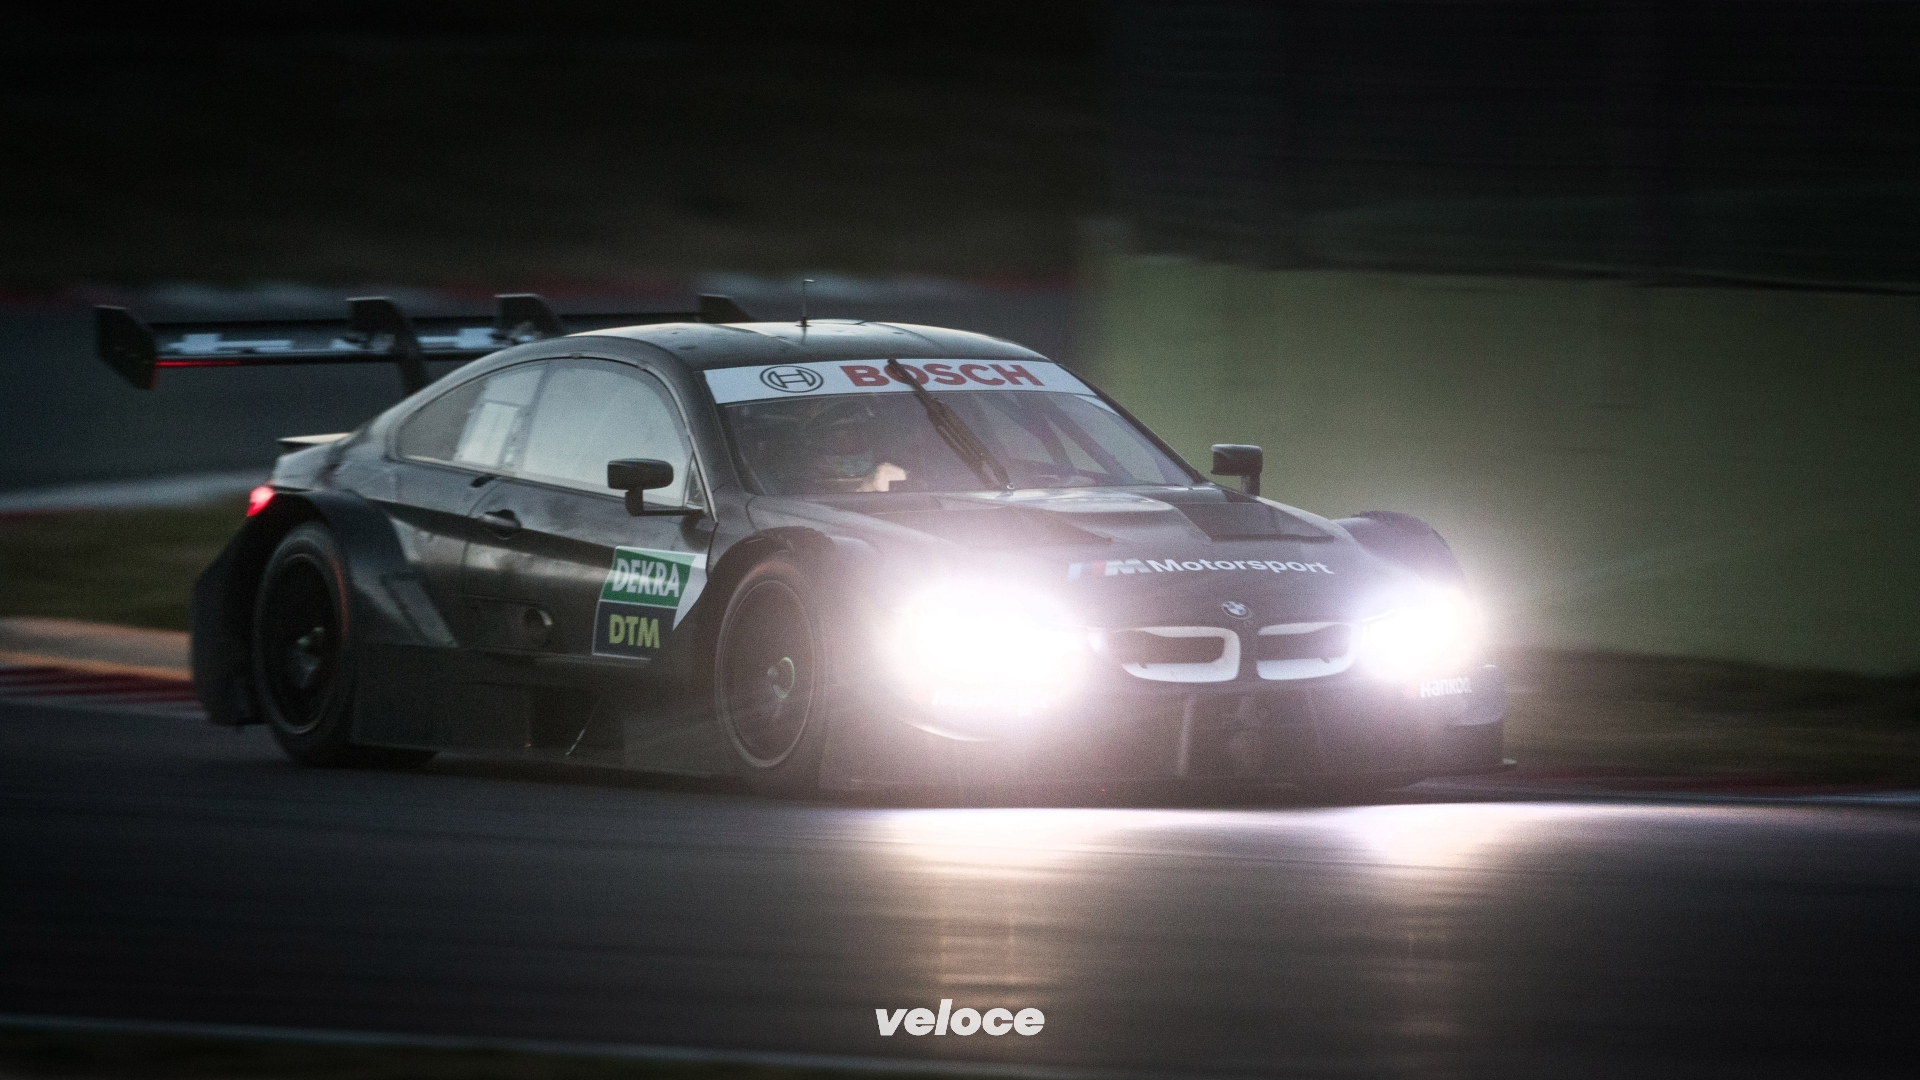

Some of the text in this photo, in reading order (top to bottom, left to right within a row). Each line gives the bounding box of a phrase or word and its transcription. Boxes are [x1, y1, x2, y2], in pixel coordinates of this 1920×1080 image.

[839, 363, 1044, 387] BOSCH
[612, 558, 680, 598] DEKRA
[1147, 559, 1334, 575] Motorsport
[608, 613, 661, 649] DTM
